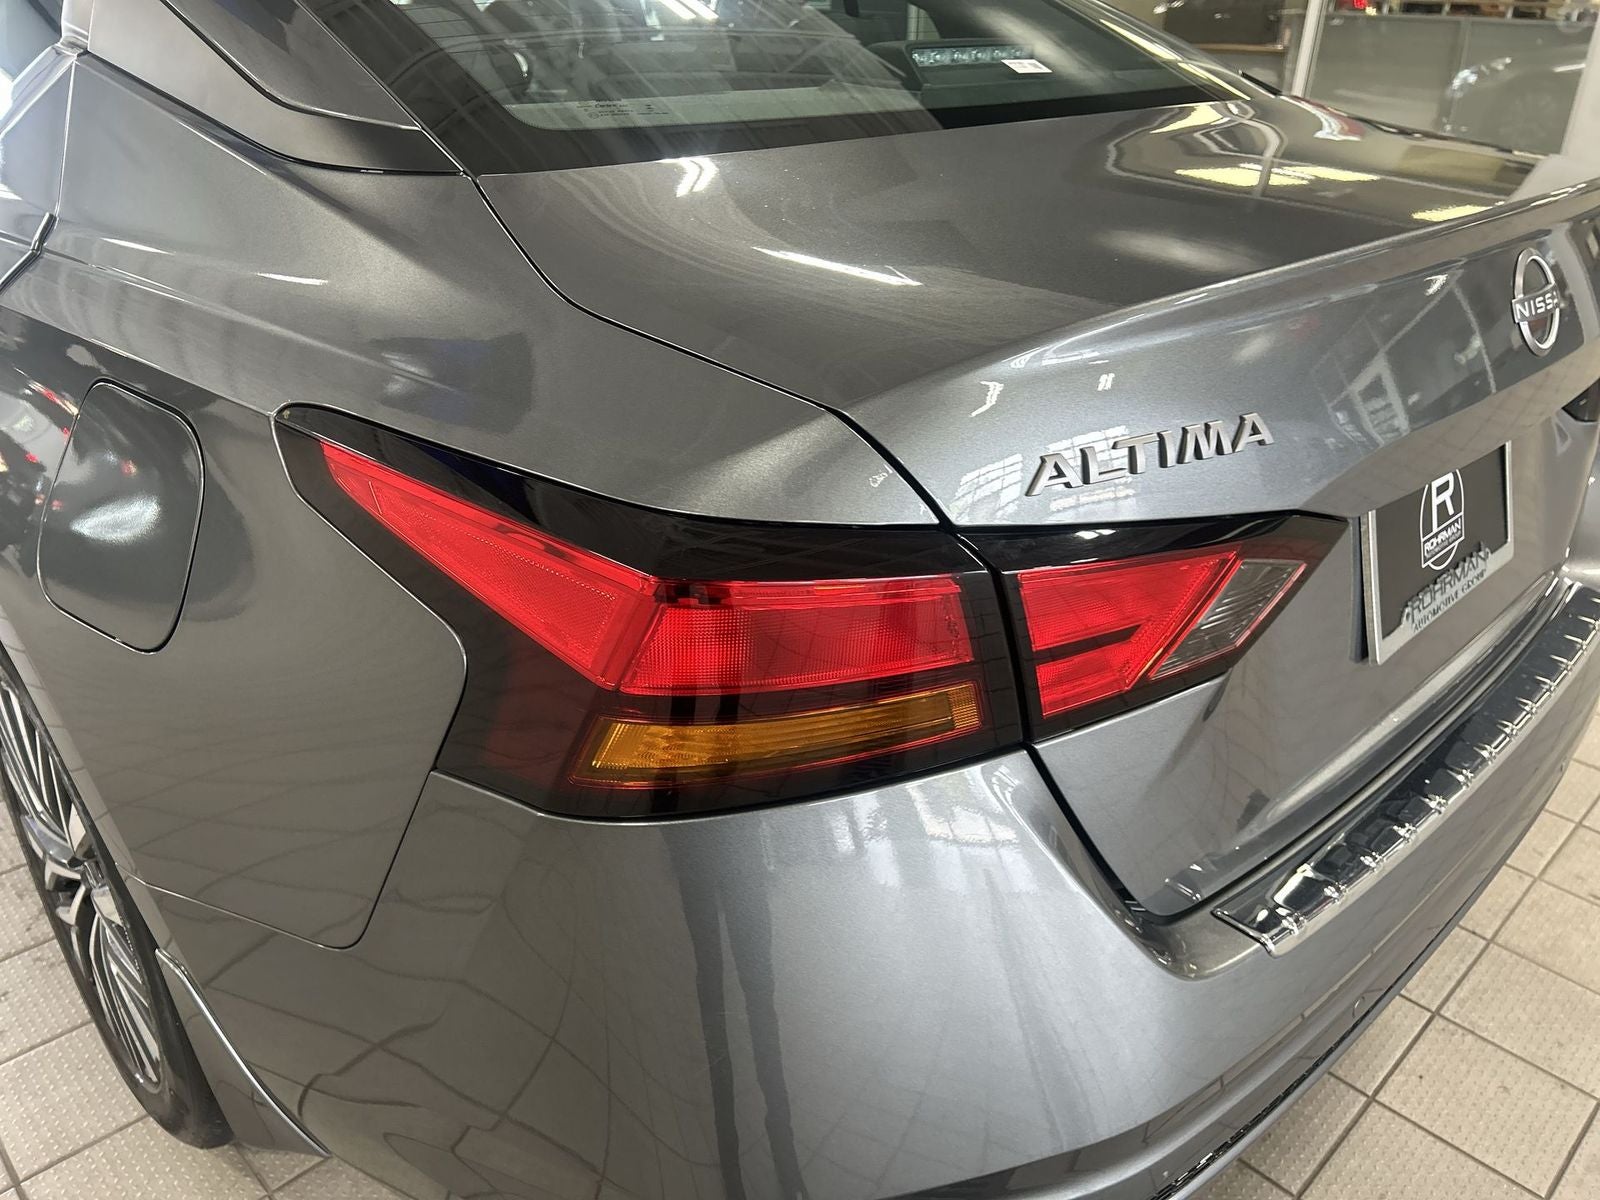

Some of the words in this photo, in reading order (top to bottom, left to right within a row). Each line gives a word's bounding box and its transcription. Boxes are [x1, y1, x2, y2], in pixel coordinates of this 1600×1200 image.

[1514, 291, 1558, 320] NISS
[1025, 411, 1275, 497] ALTIMA
[1430, 471, 1455, 534] R
[1423, 517, 1462, 558] ROHRMAN
[1407, 541, 1489, 625] ROHRMAN
[1413, 589, 1459, 633] AUTOMOTIVE
